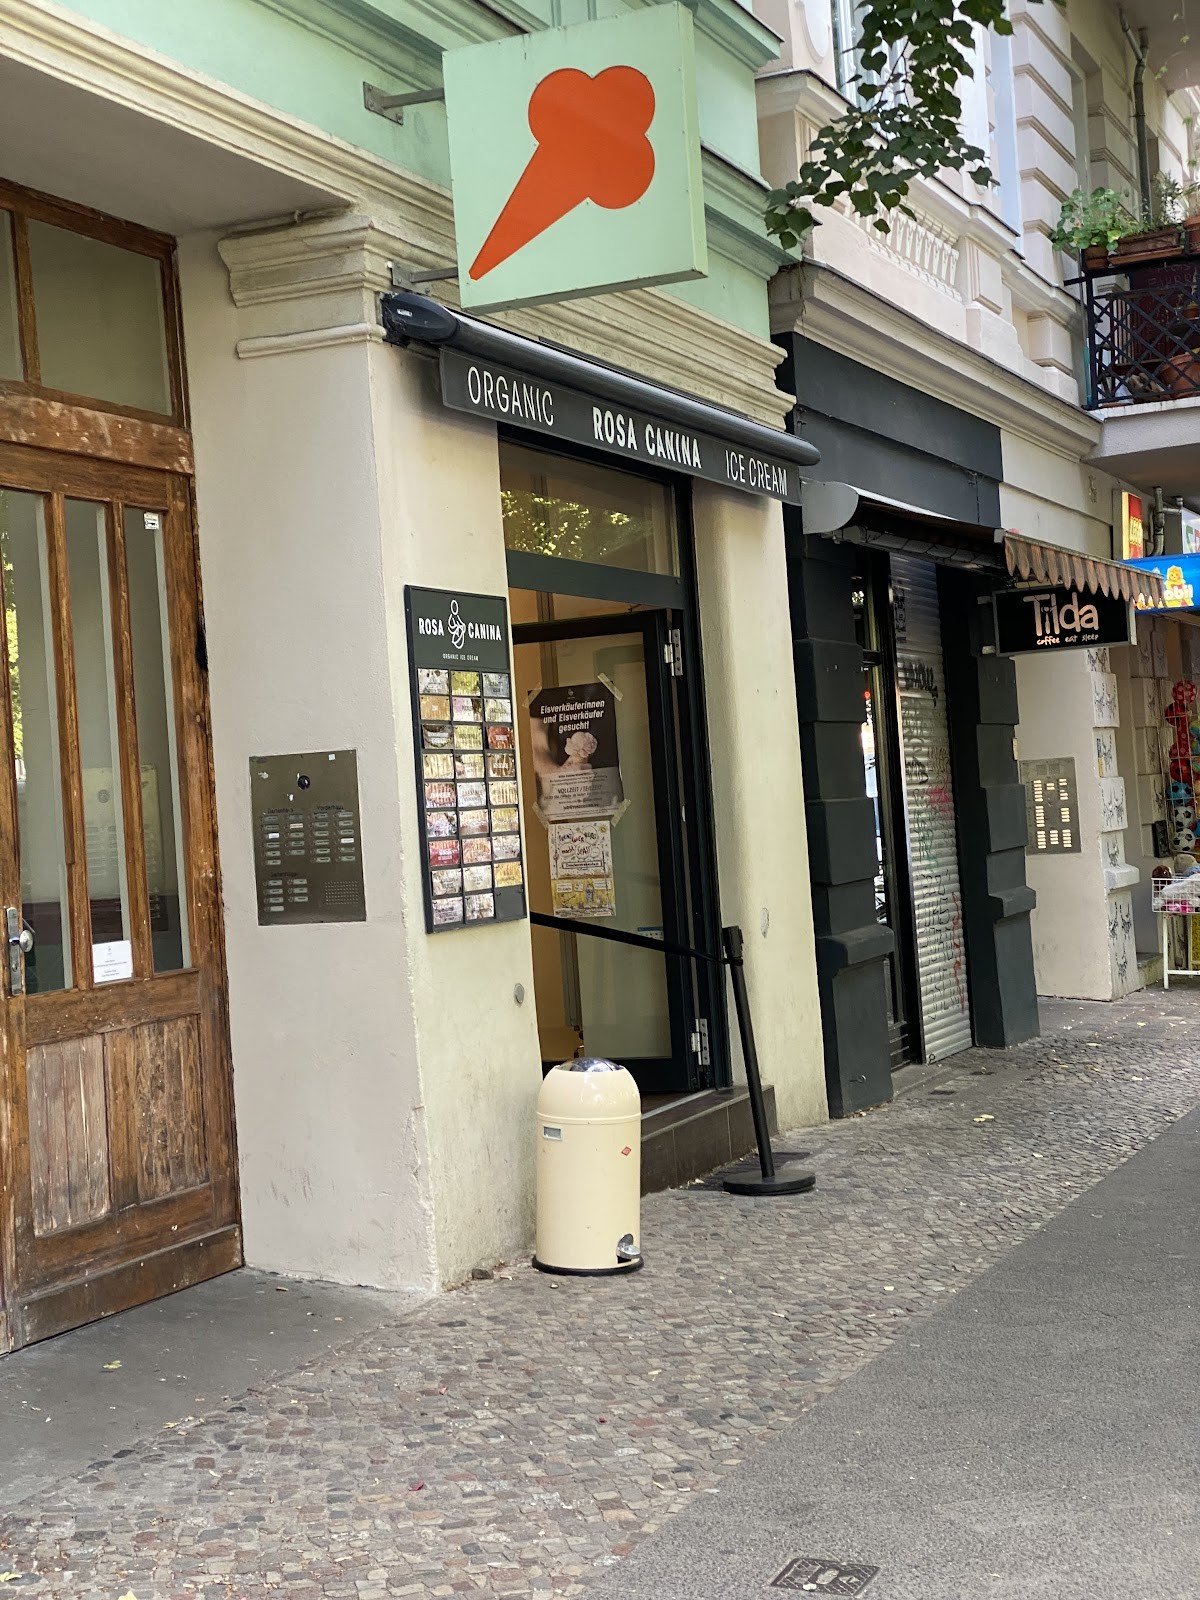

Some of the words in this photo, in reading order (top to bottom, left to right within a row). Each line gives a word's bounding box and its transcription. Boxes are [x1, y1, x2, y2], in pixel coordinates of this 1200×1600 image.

[467, 366, 555, 426] ORGANIC
[592, 406, 638, 451] ROSA
[645, 424, 702, 469] CANINA
[725, 450, 746, 482] ICE
[748, 454, 788, 496] CREAM
[1023, 593, 1099, 636] Tilda
[418, 617, 444, 636] ROSA
[468, 622, 502, 641] CANINA
[1036, 635, 1061, 645] coffee
[1064, 635, 1078, 643] eat
[1081, 633, 1099, 642] sleep
[540, 699, 605, 715] Eisverkäuferinnen
[543, 714, 557, 724] und
[558, 709, 605, 722] Eisverkäufer
[558, 720, 590, 734] gesucht!
